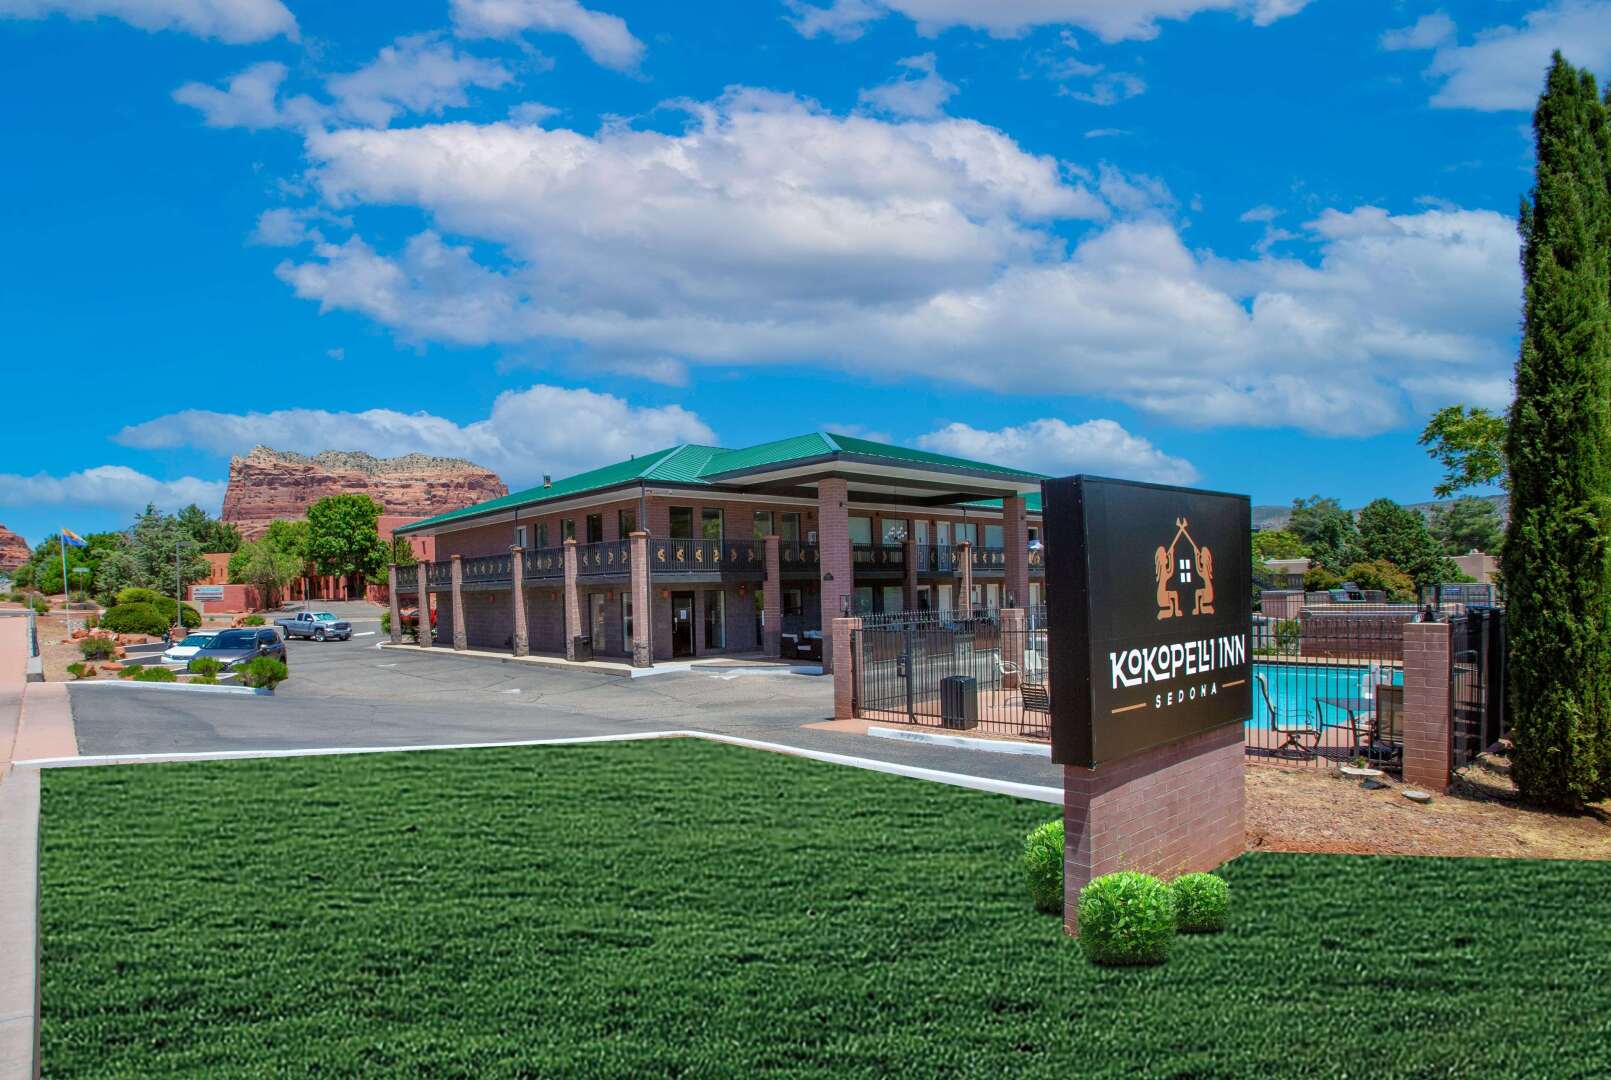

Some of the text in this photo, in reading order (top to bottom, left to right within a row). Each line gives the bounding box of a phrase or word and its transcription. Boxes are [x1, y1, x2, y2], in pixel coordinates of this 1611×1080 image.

[1109, 634, 1246, 689] KOKOPELLI INN
[1155, 682, 1217, 709] SEDONA
